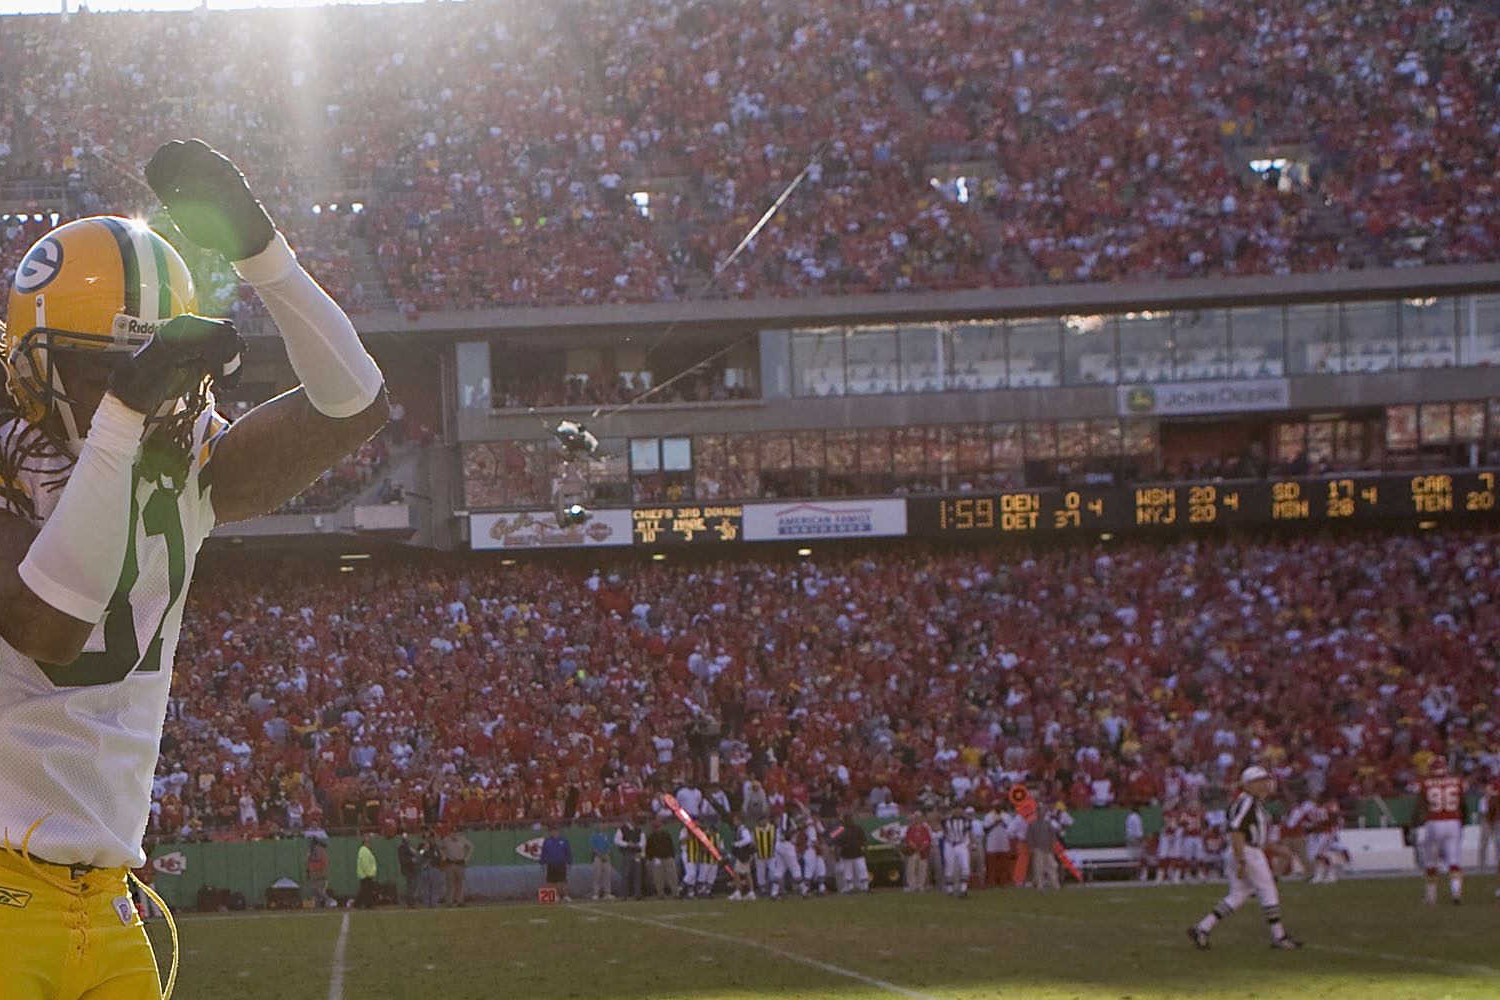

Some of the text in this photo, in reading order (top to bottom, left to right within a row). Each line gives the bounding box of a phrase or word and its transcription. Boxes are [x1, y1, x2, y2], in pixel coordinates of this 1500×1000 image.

[1328, 480, 1354, 499] 17
[1478, 473, 1494, 490] 7
[1001, 491, 1080, 512] DEN 0
[1189, 486, 1216, 504] 20
[1223, 492, 1239, 511] 4
[1361, 486, 1378, 505] 4
[1467, 491, 1494, 510] 20
[633, 509, 673, 520] CHIEFS
[677, 507, 700, 518] 3RD
[940, 499, 994, 529] 1:59
[1088, 499, 1103, 517] 4
[1136, 504, 1216, 525] NYJ 20
[1002, 510, 1081, 530] DET 37
[540, 890, 556, 903] 20
